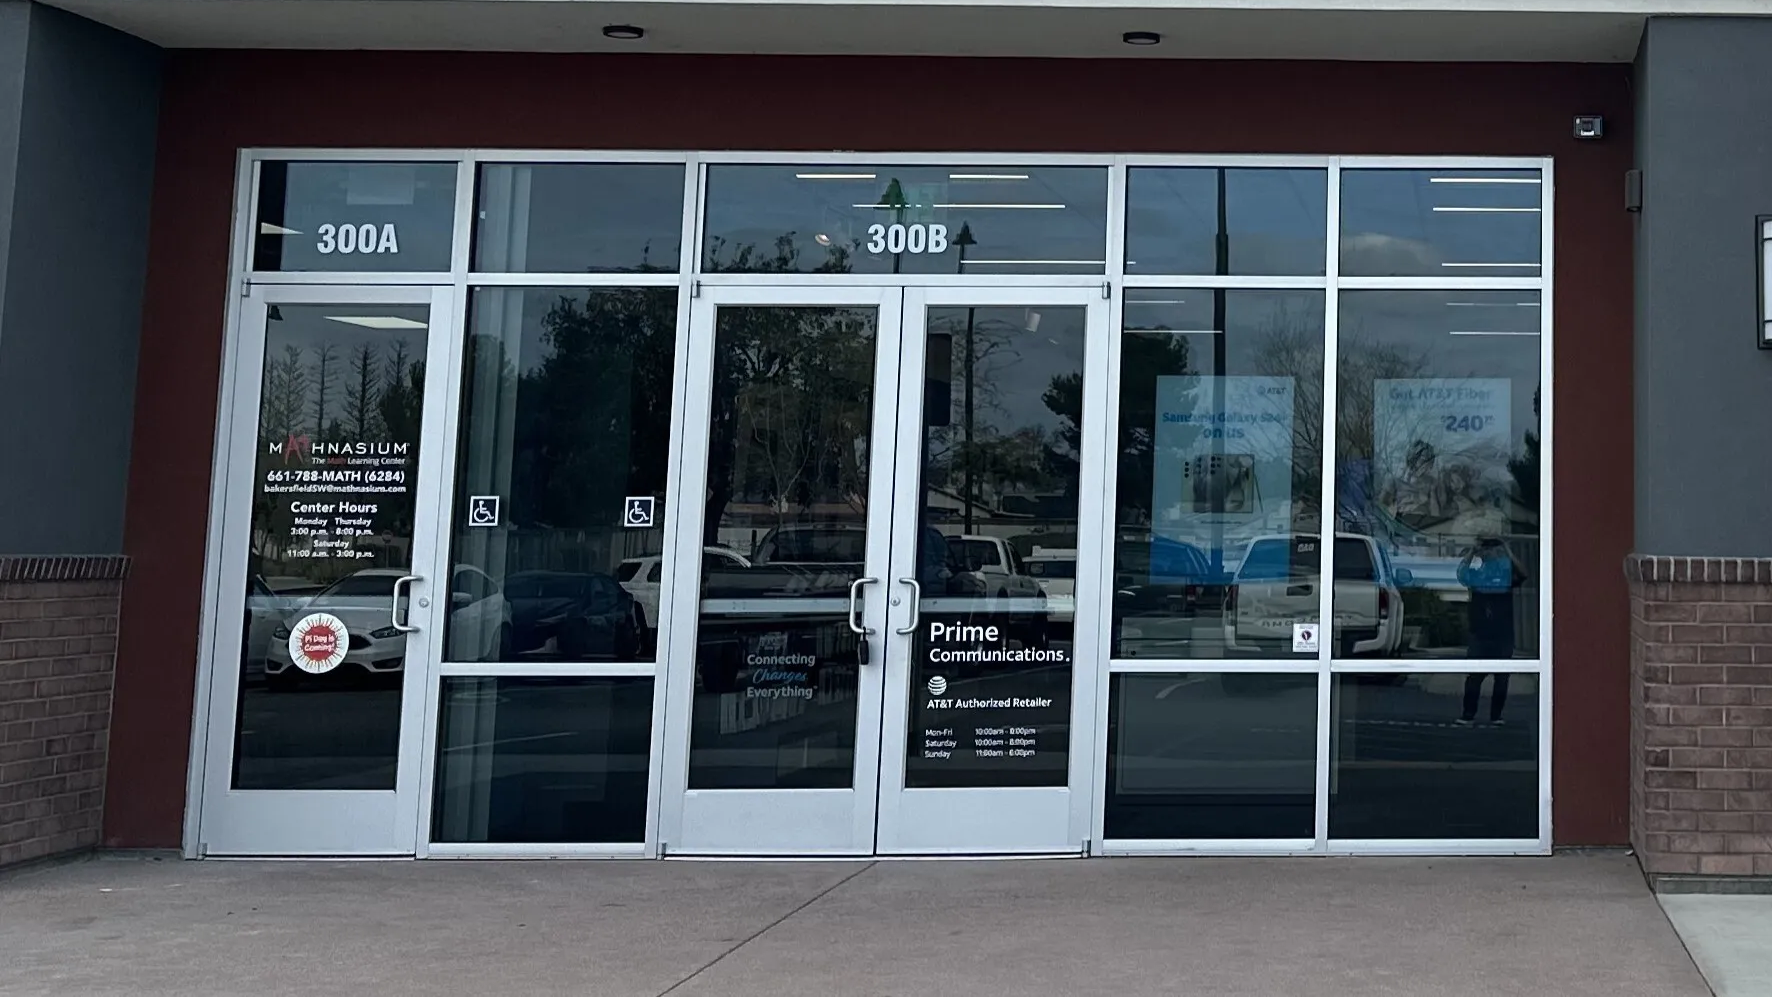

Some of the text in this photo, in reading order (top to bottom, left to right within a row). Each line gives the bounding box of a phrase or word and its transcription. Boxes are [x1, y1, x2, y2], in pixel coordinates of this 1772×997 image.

[316, 223, 398, 254] 300A
[867, 224, 948, 254] 300B
[347, 457, 379, 466] Learning
[381, 457, 405, 465] Center
[267, 470, 405, 483] 661-788-MATH (6284)
[290, 501, 378, 513] Center Hours
[294, 517, 372, 527] Monday Thursday
[290, 527, 309, 535] 3:00
[313, 539, 350, 549] Saturday
[336, 549, 355, 558] 3:00
[930, 621, 999, 642] Prime
[747, 653, 816, 667] Connecting
[929, 647, 1070, 663] Communications.
[752, 668, 808, 684] Changes
[927, 697, 1052, 709] AT&T Authorized Retailer
[925, 728, 953, 737] Mon-Fri
[925, 739, 957, 748] Saturday
[924, 750, 951, 759] Sunday
